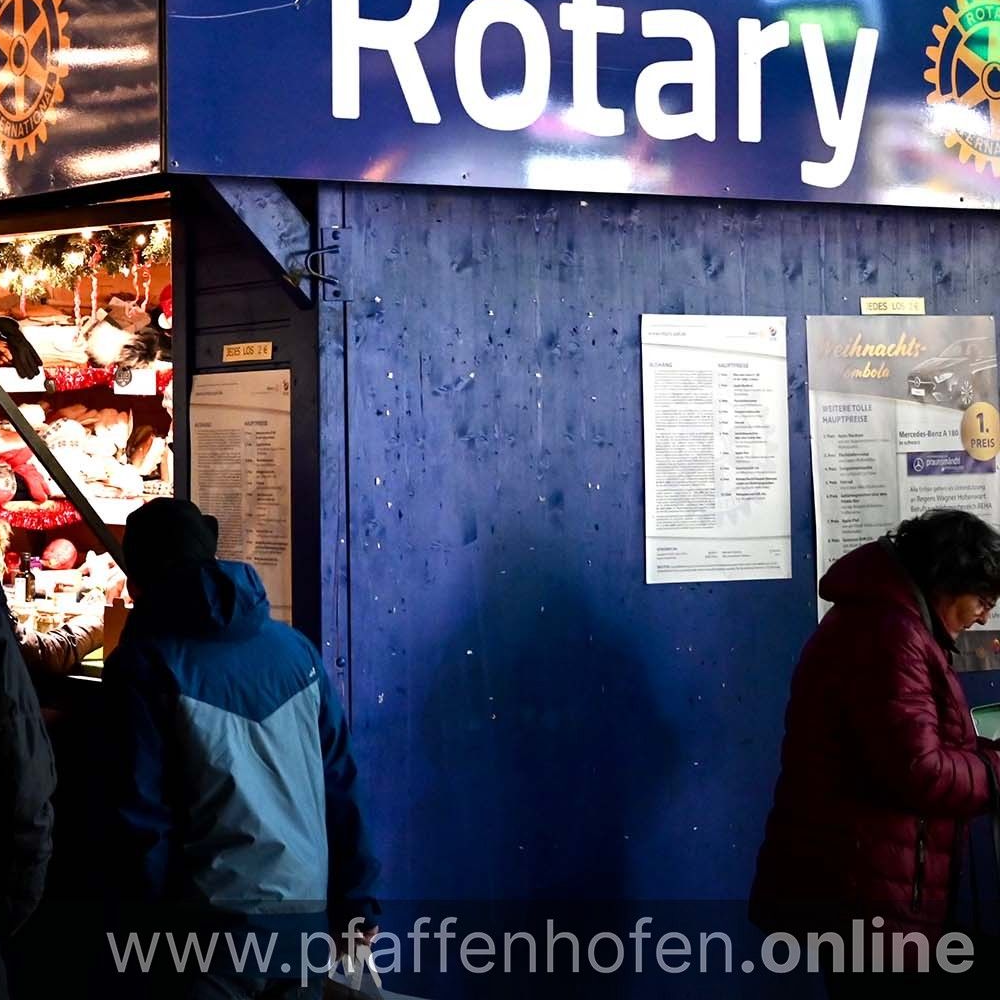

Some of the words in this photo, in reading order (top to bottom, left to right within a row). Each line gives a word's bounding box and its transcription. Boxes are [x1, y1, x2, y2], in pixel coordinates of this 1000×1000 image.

[243, 345, 254, 356] LOS
[823, 404, 851, 413] WEITERE
[852, 403, 872, 412] TOLLE
[822, 415, 868, 424] HAUPTPREISE
[976, 412, 990, 433] 1.
[899, 430, 941, 438] Mercedes-Benz
[970, 438, 995, 449] PREIS
